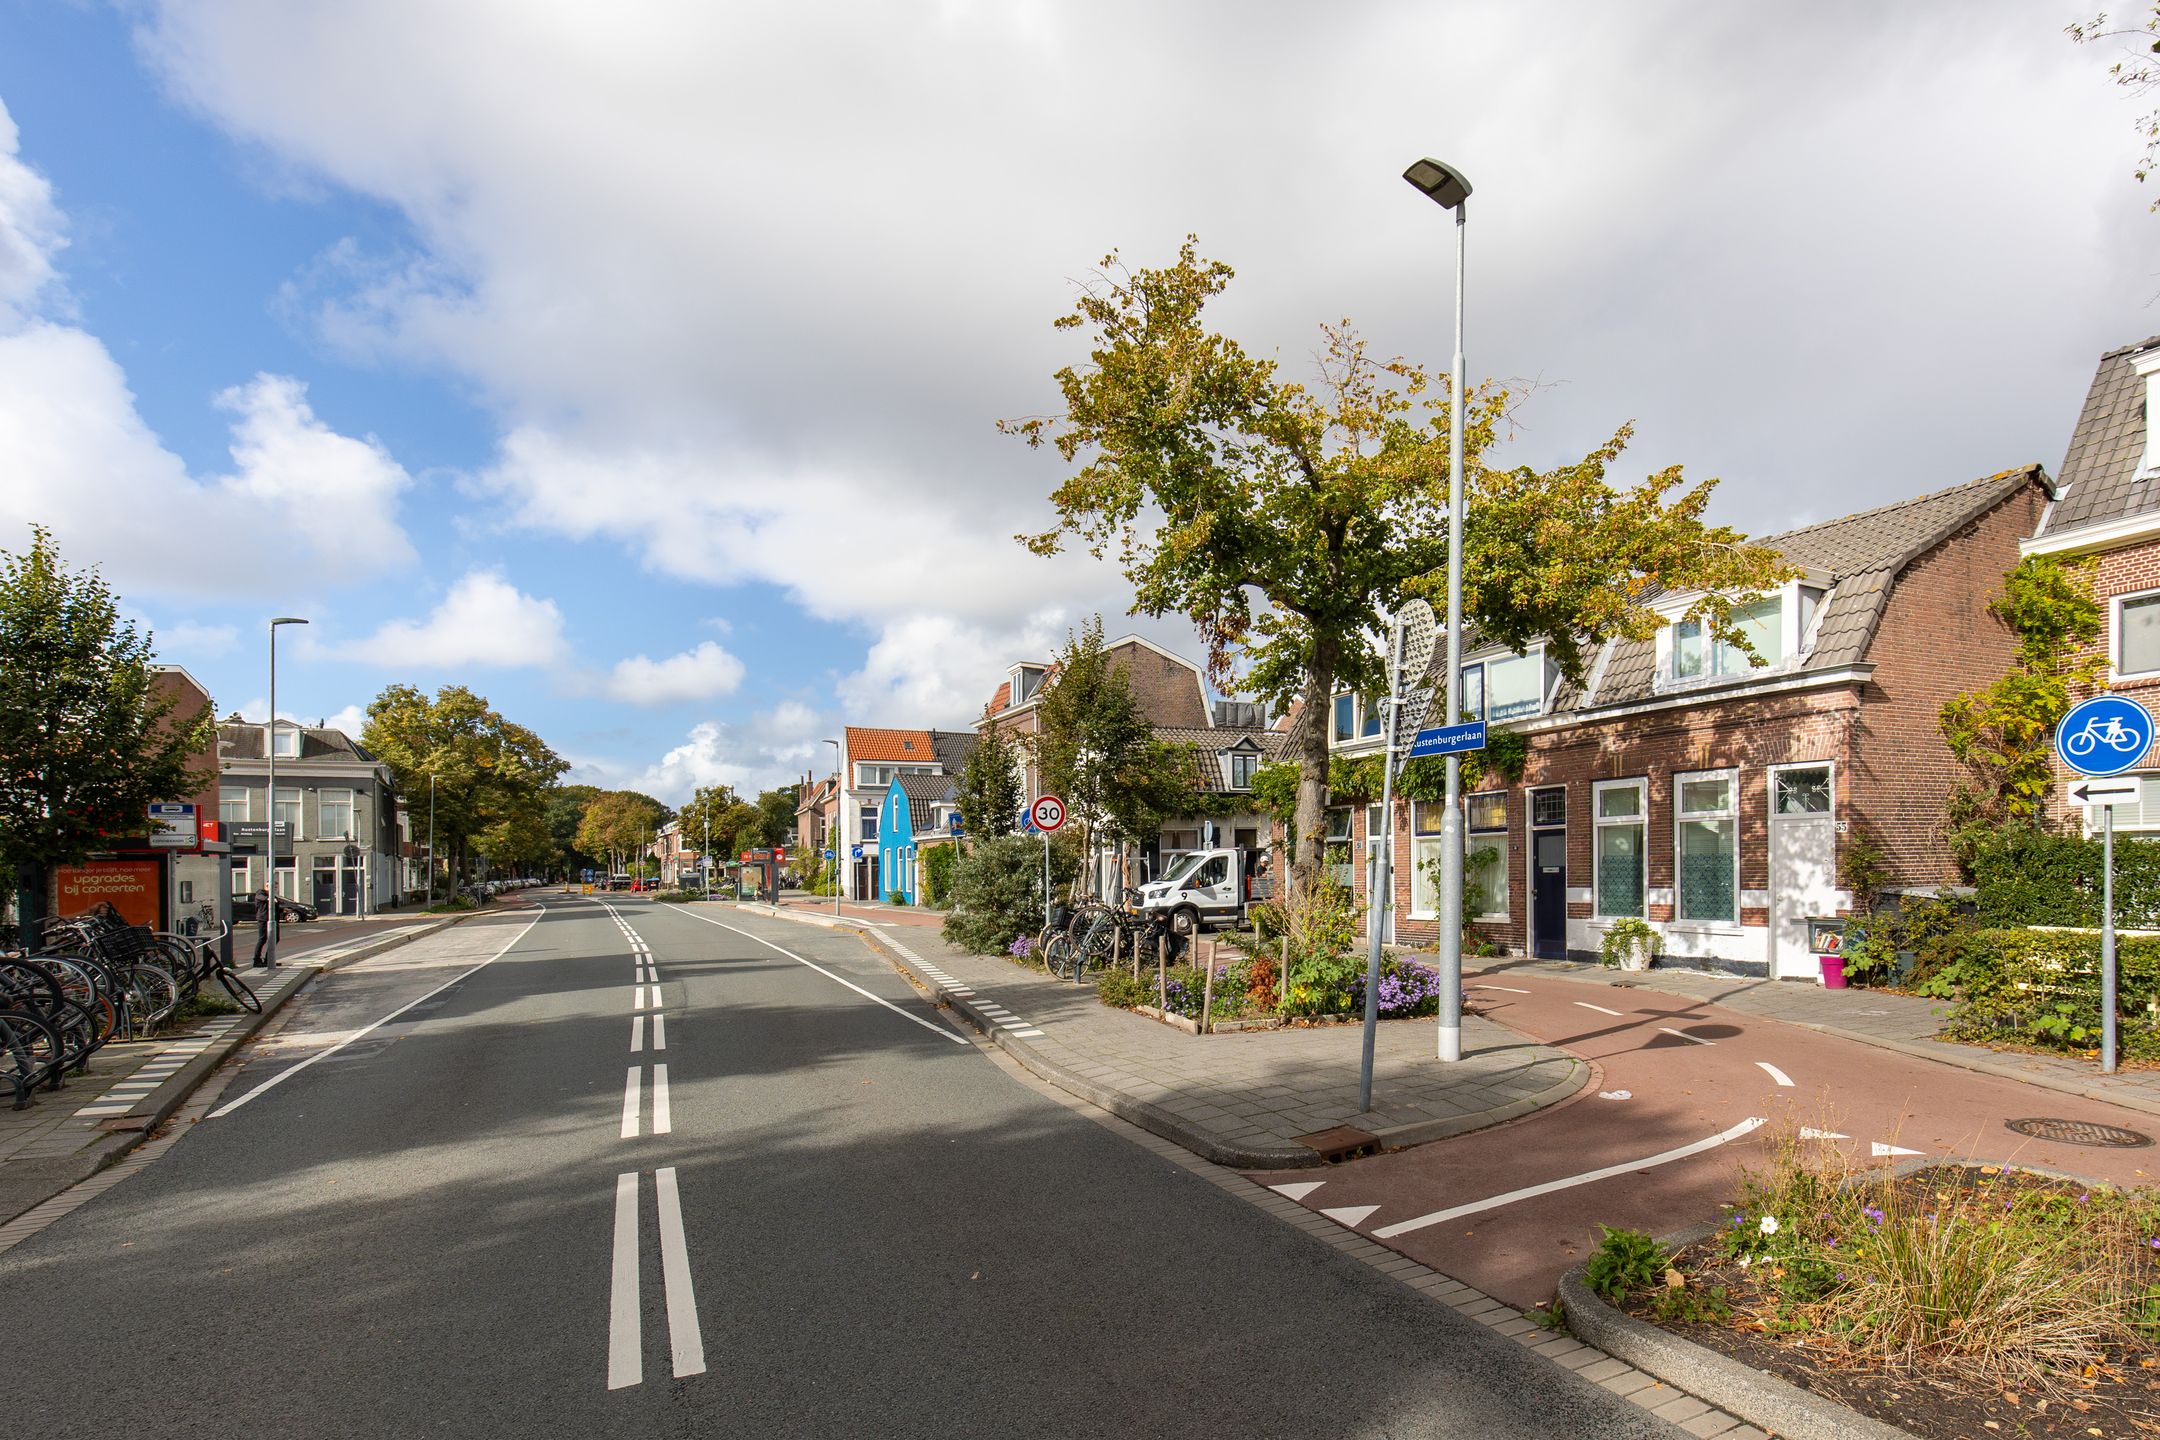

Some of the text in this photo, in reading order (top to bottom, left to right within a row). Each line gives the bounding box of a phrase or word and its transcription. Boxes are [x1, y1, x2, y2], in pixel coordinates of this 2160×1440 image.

[1414, 731, 1482, 747] ustenburgerlaan
[1038, 807, 1060, 820] 30
[1836, 822, 1847, 831] 55
[73, 874, 136, 884] upgrades
[64, 884, 145, 895] bij concerten
[1181, 892, 1188, 900] 9
